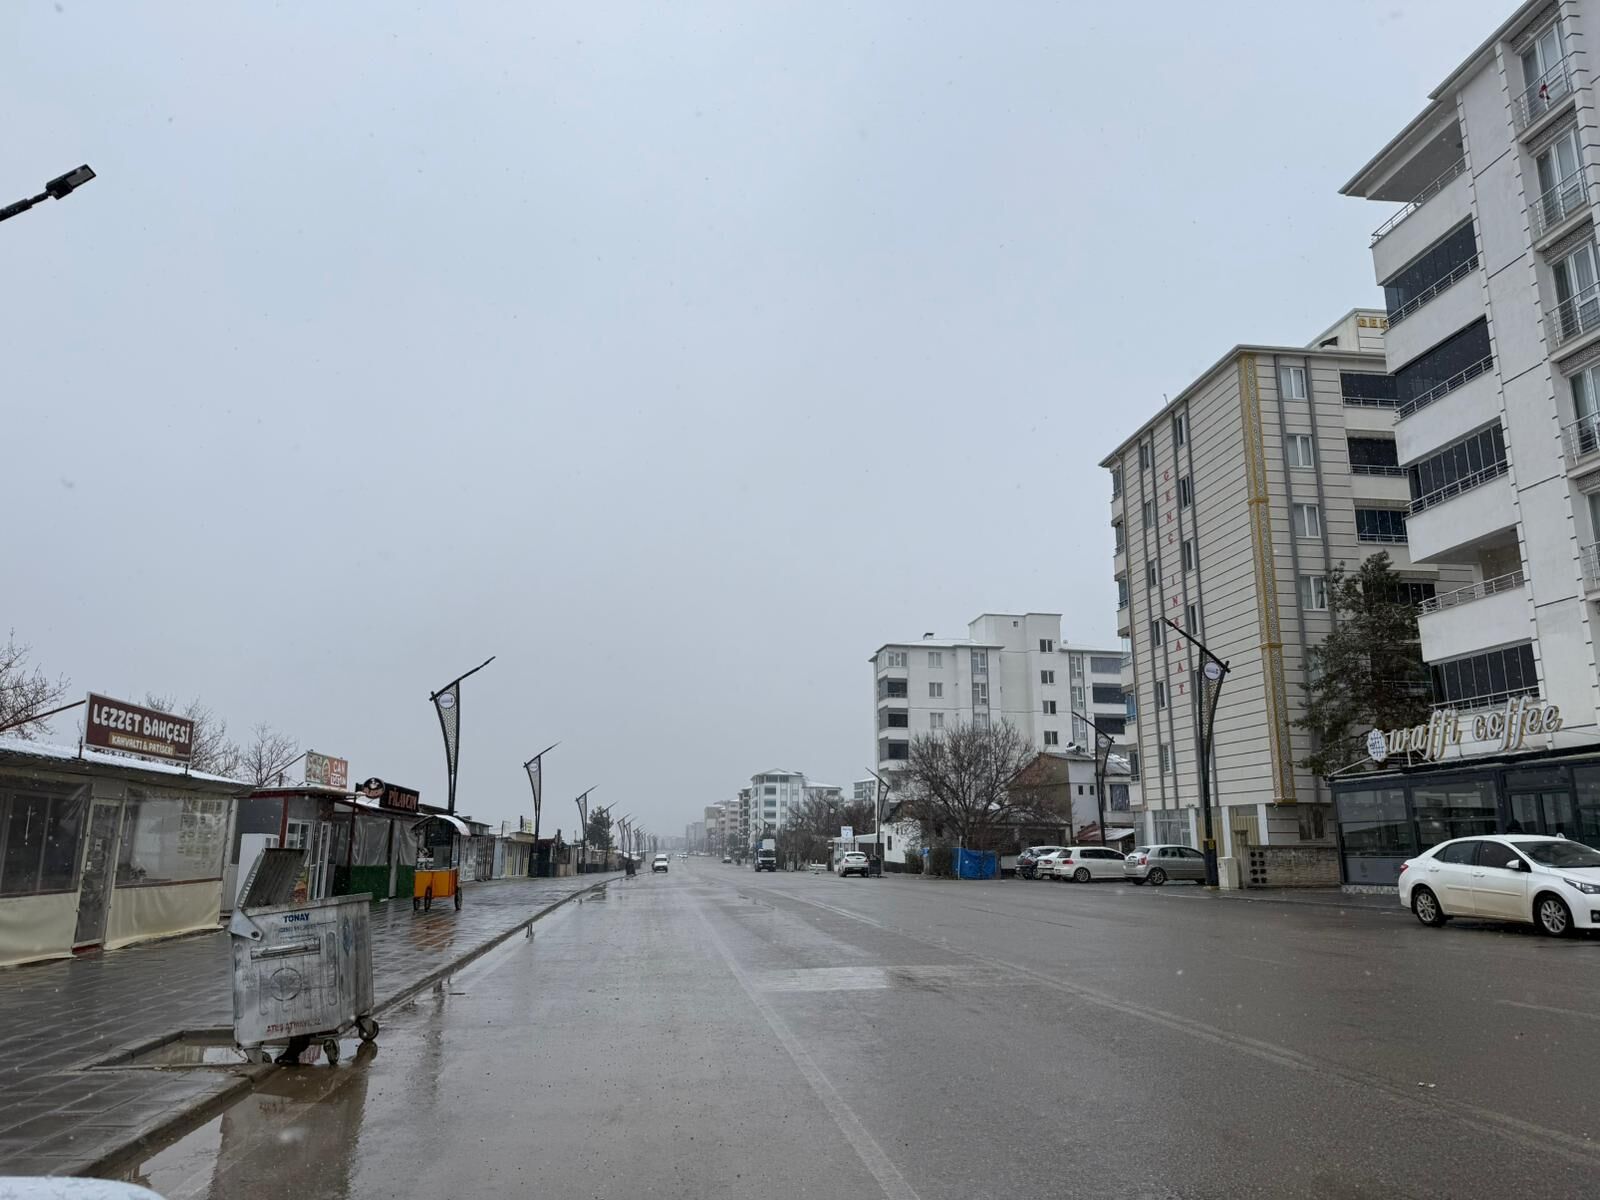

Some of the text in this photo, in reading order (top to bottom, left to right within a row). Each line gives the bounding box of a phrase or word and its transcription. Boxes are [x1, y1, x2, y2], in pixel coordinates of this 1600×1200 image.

[93, 703, 189, 743] LEZZET BAHÇESİ
[1389, 696, 1563, 760] waffi coffee
[283, 912, 310, 923] TONAY
